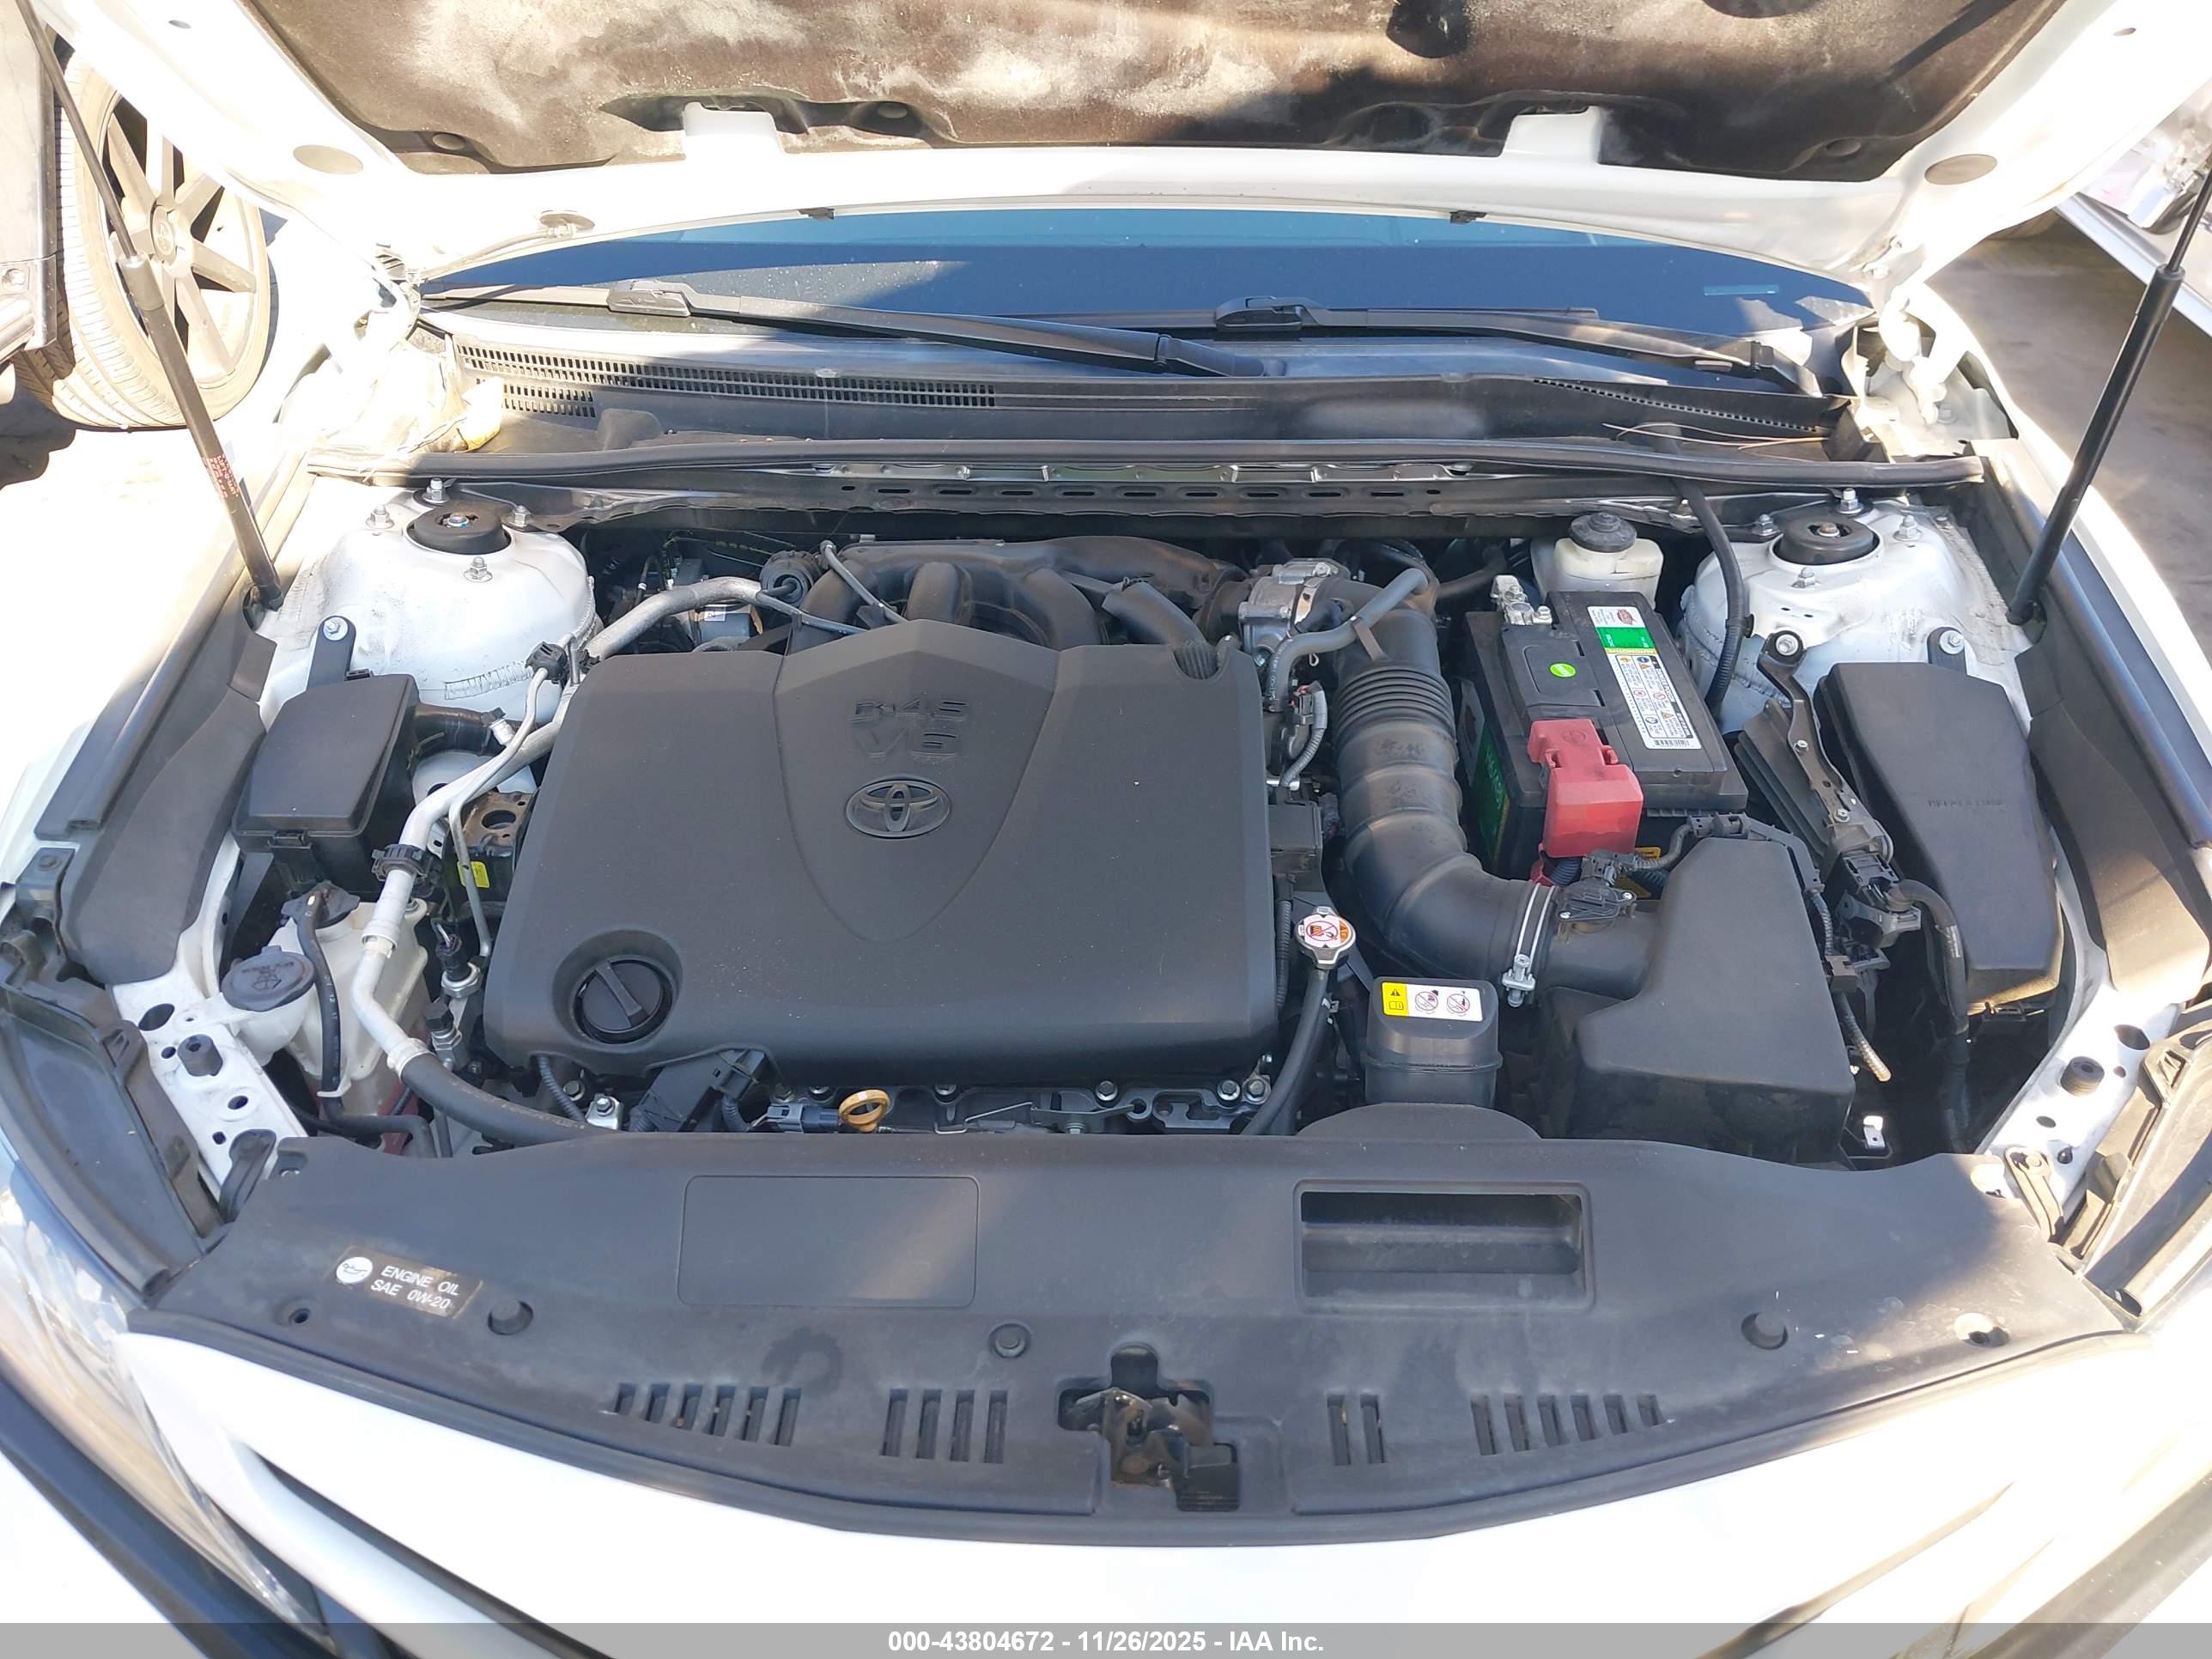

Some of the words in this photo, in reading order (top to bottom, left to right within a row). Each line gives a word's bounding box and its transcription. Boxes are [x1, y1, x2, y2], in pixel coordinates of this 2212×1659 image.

[855, 727, 957, 758] V6
[370, 1279, 403, 1296] SAE
[407, 1289, 453, 1310] 0W-20
[381, 1266, 433, 1287] ENGINE
[437, 1281, 460, 1296] OIL
